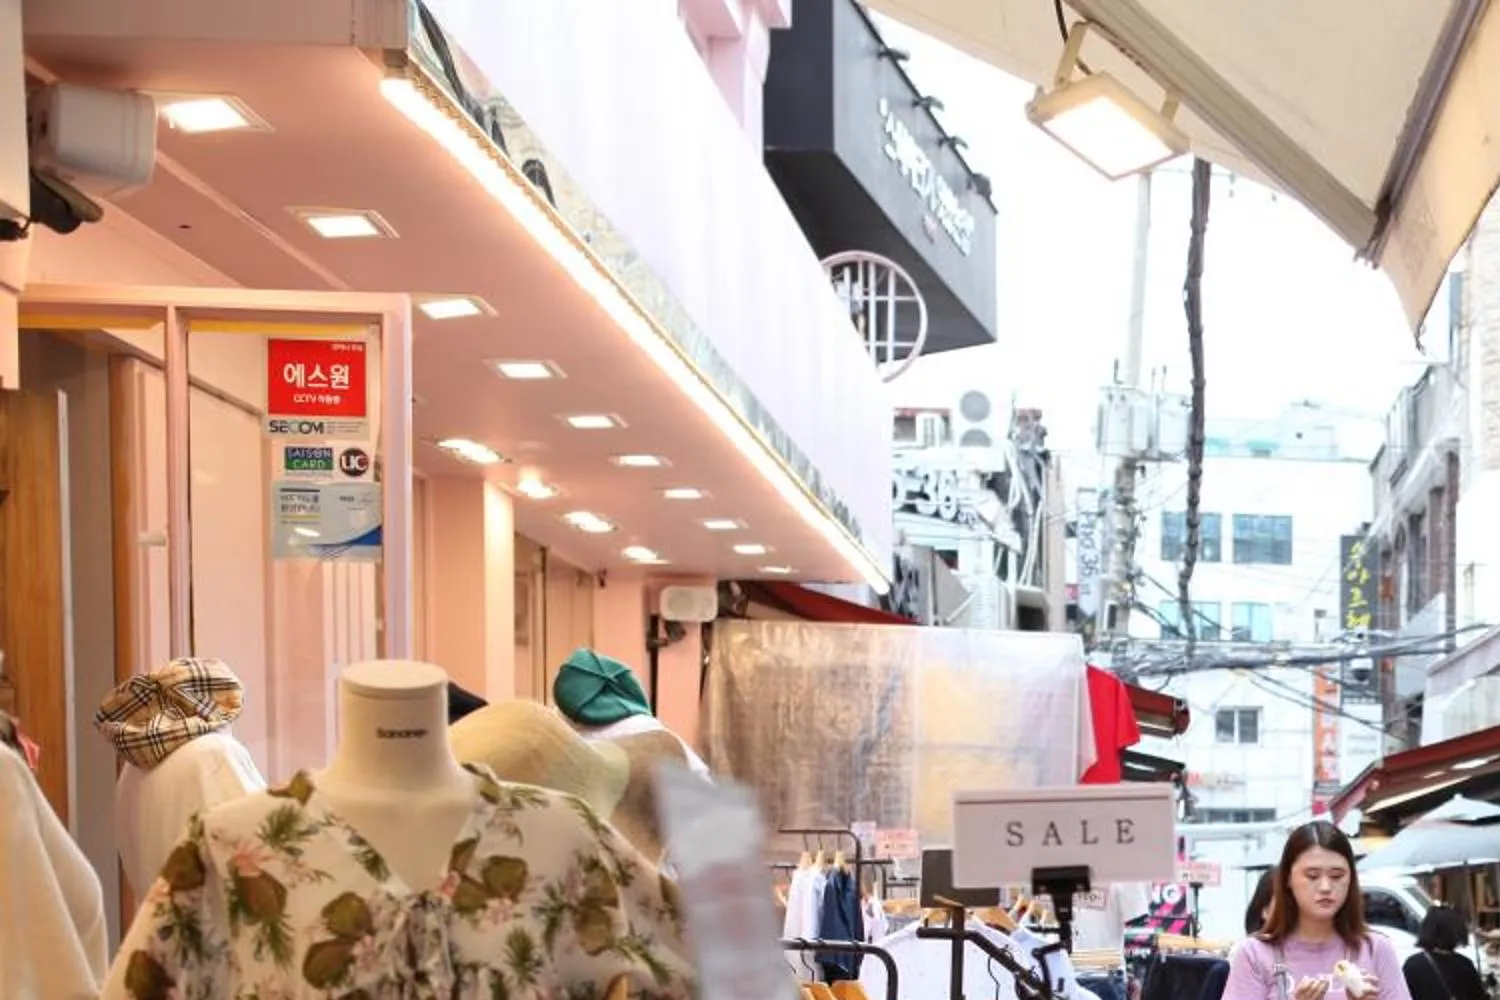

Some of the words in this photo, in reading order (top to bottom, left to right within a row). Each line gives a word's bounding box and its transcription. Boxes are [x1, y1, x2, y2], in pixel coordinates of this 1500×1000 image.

[283, 362, 350, 390] 에스원
[269, 420, 324, 434] SECOM
[1006, 819, 1135, 847] SALE
